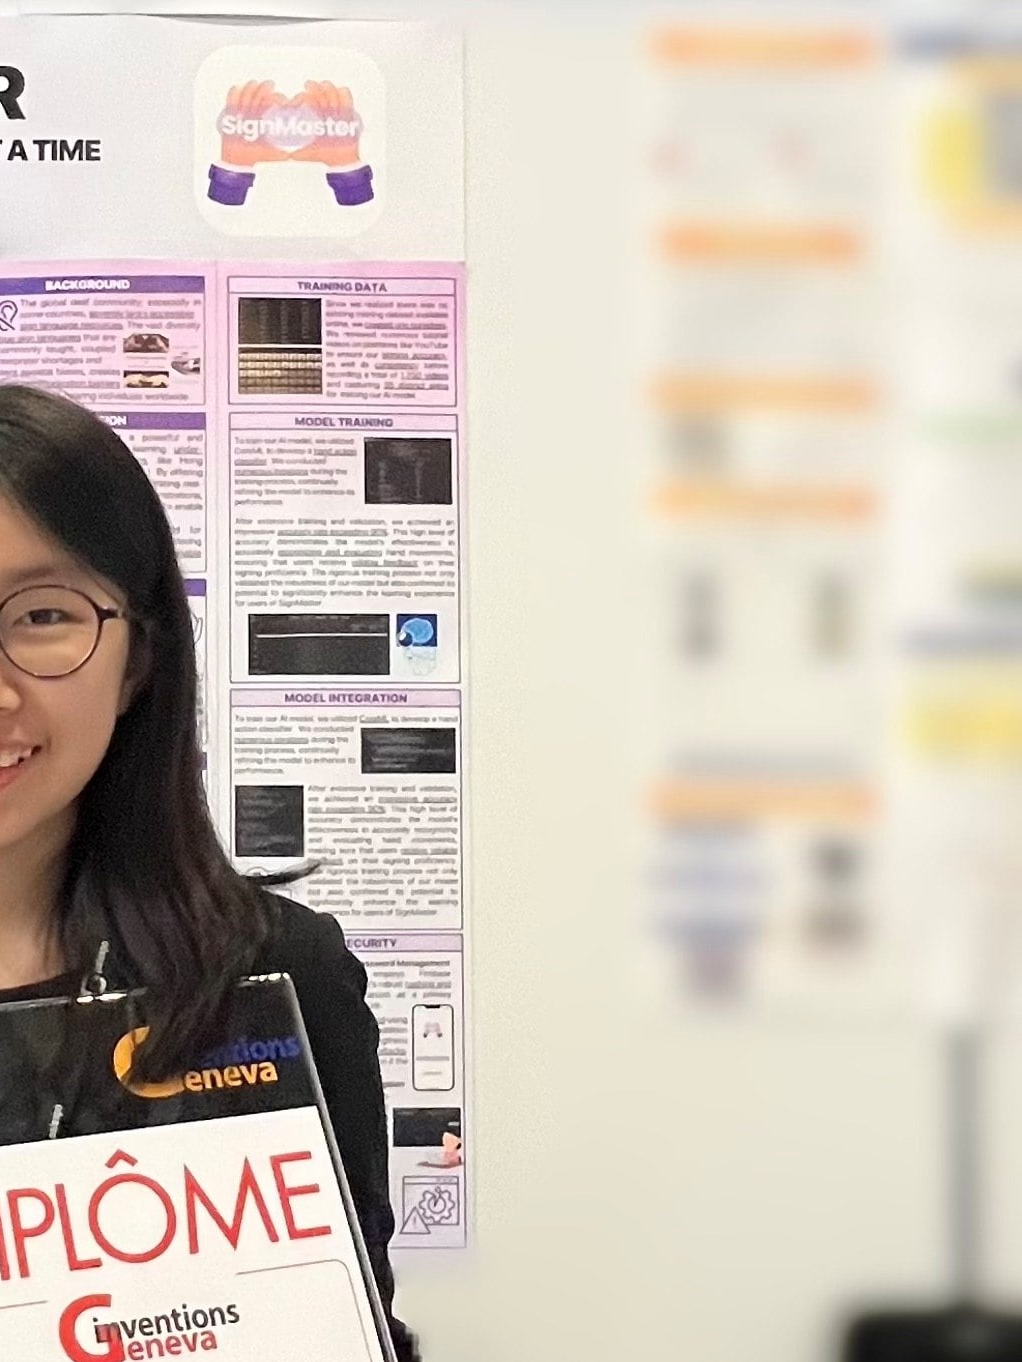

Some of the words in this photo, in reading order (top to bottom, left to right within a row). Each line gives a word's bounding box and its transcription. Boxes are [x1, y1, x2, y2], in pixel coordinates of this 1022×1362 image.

[221, 113, 361, 142] SignMaster
[7, 139, 29, 161] A
[33, 138, 101, 162] TIME
[45, 280, 130, 291] BACKGROUND
[297, 282, 352, 292] TRAINING
[355, 282, 387, 292] DATA
[295, 417, 336, 427] MODEL
[337, 418, 394, 428] TRAINING
[284, 693, 326, 703] MODEL
[329, 693, 408, 703] INTEGRATION
[91, 1302, 241, 1344] inventions
